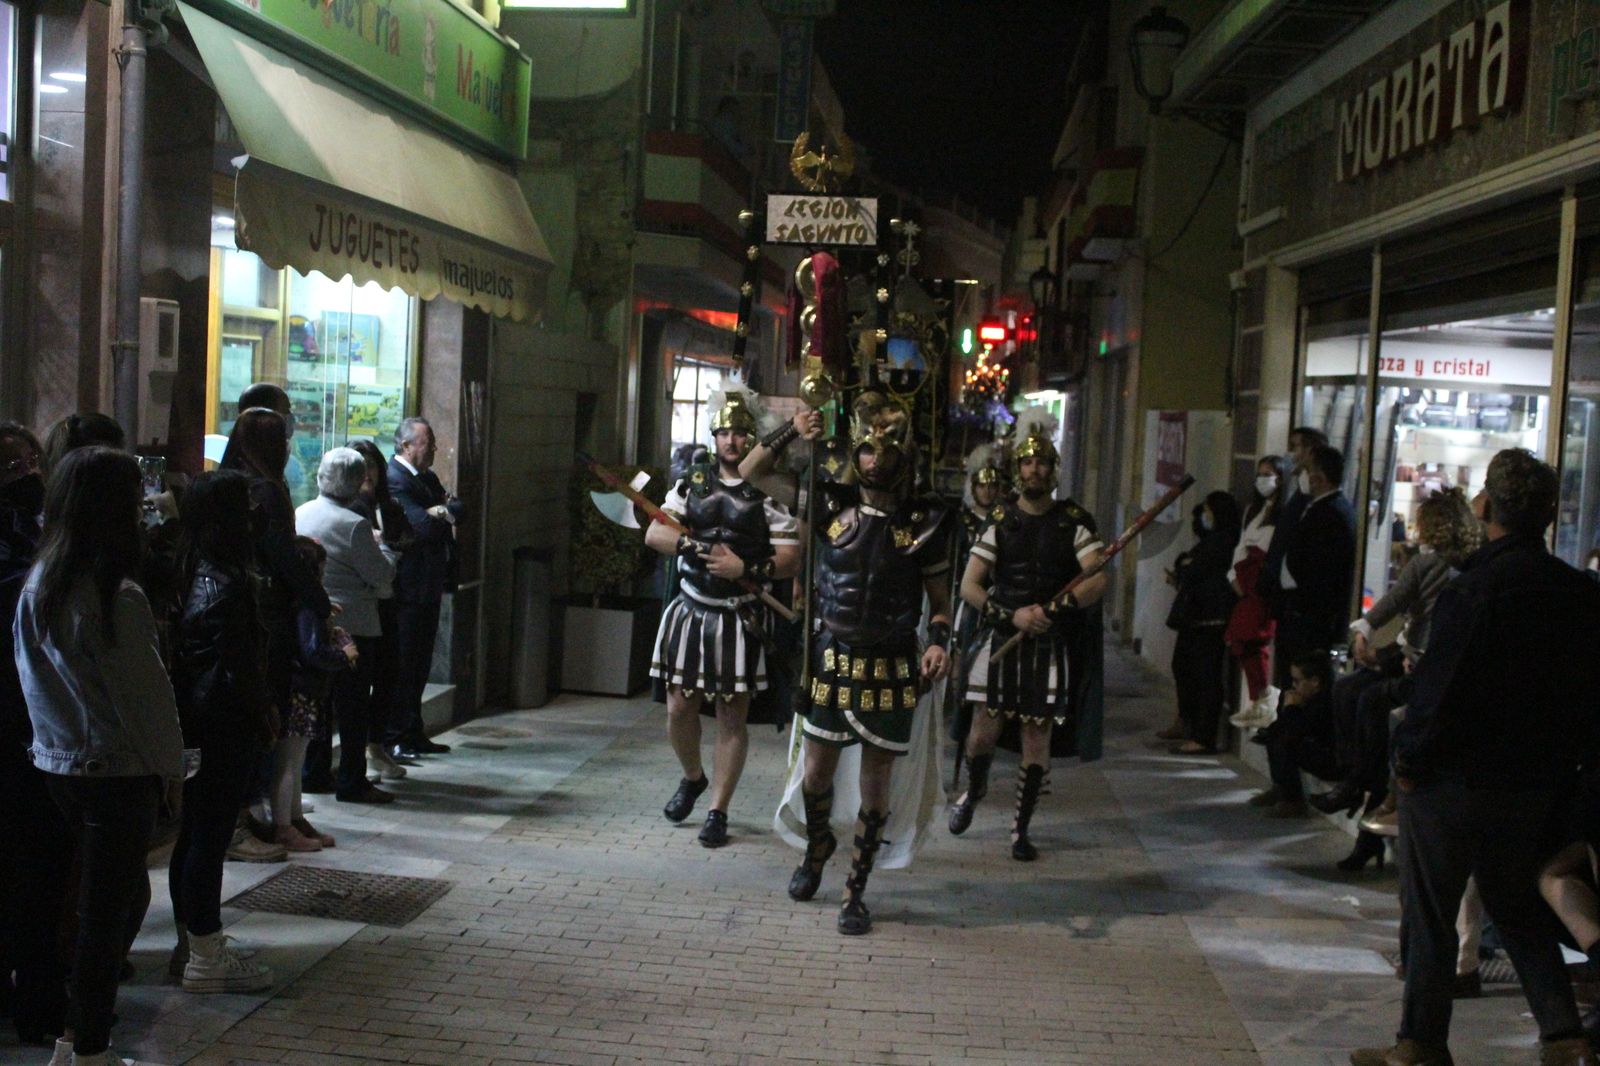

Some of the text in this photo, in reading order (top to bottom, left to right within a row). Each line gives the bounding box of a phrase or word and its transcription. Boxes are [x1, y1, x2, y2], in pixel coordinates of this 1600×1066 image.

[1335, 0, 1512, 182] MORATA
[1548, 22, 1600, 134] pe
[310, 204, 514, 301] JUGUETES majuelos
[784, 199, 861, 220] LEGION
[1415, 359, 1424, 377] y
[1433, 358, 1490, 377] cristal
